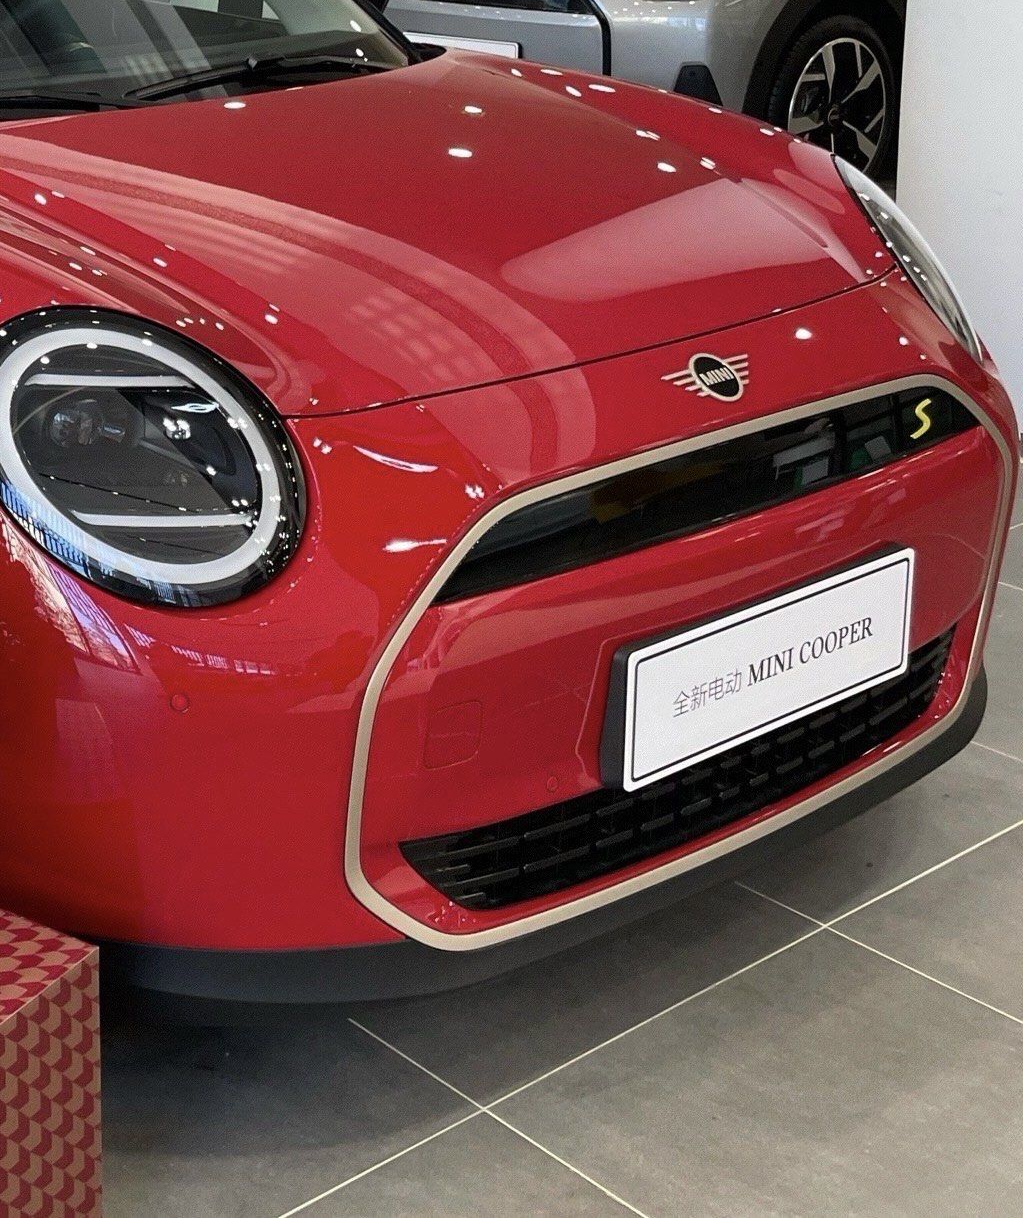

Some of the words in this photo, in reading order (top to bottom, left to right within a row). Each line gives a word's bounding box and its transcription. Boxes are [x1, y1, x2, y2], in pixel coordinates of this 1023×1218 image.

[699, 366, 734, 386] MINI
[910, 398, 932, 439] S
[673, 668, 742, 717] 全新电动
[747, 647, 794, 687] MINI
[799, 616, 874, 665] COOPER
